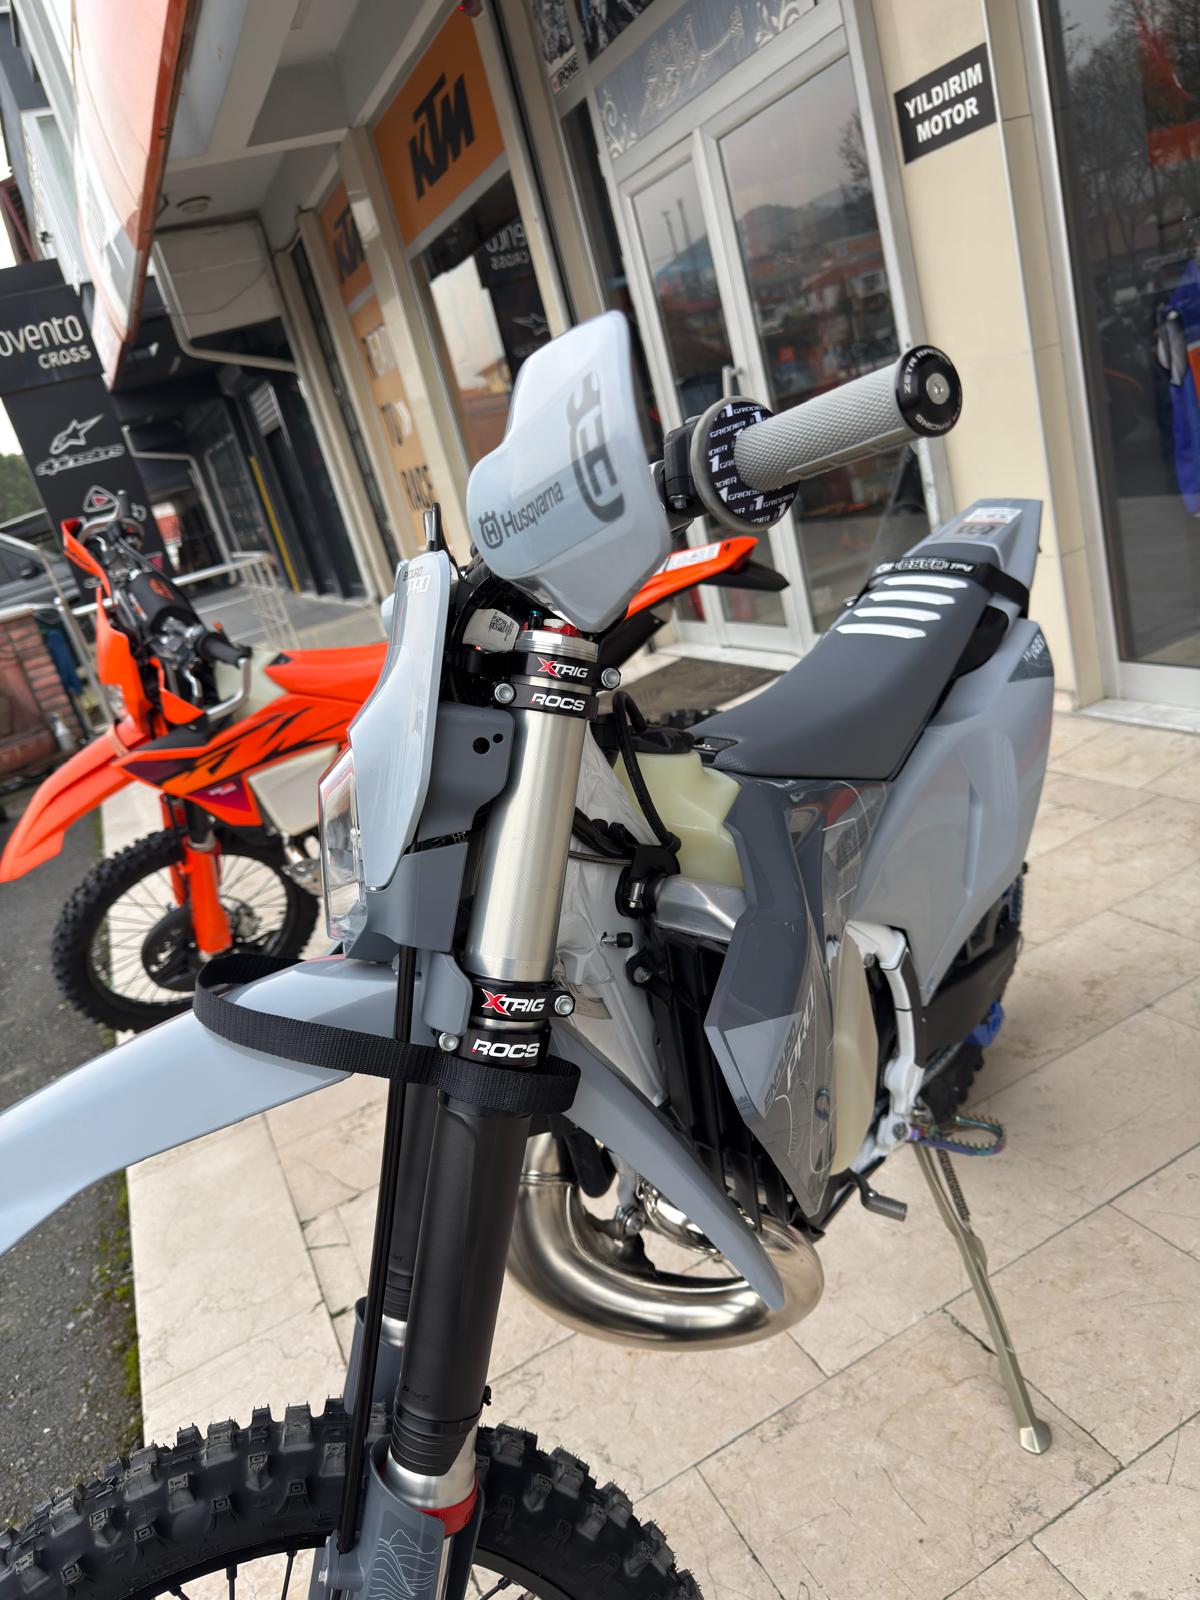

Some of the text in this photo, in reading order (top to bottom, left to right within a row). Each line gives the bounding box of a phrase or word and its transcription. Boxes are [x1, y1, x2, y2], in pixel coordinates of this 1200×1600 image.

[904, 62, 984, 119] YILDIRIM
[915, 97, 980, 144] MOTOR
[408, 72, 476, 203] KTM
[38, 344, 92, 370] CROSS
[500, 480, 564, 538] Husqvarna
[537, 656, 589, 679] XTRIG
[530, 692, 586, 712] ROCS
[481, 987, 546, 1017] XTRIG
[471, 1038, 540, 1059] ROCS
